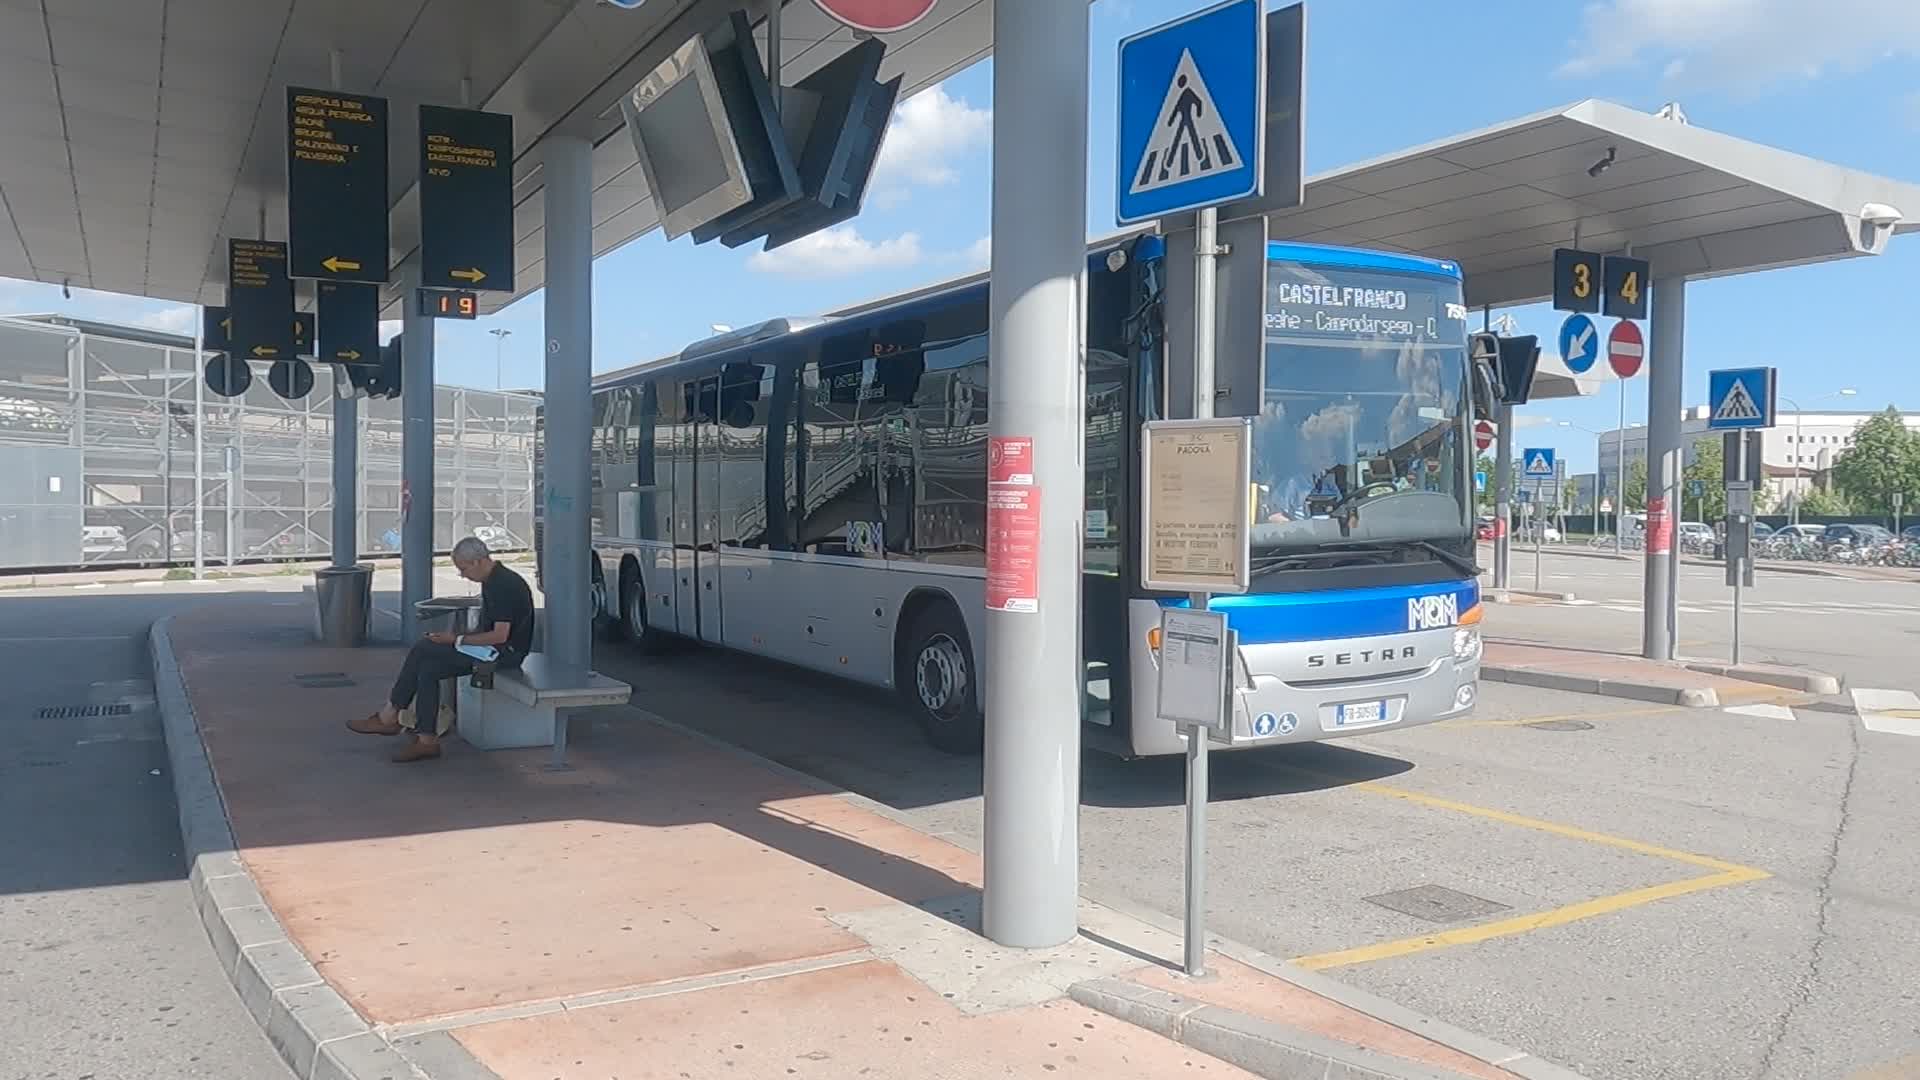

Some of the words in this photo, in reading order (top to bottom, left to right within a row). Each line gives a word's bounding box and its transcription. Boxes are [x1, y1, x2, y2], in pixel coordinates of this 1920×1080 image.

[1575, 263, 1591, 298] 3
[1621, 271, 1639, 305] 4
[1279, 283, 1407, 310] CASTELFRANCO
[1176, 446, 1212, 455] PADOVA
[1308, 645, 1416, 668] SETRA
